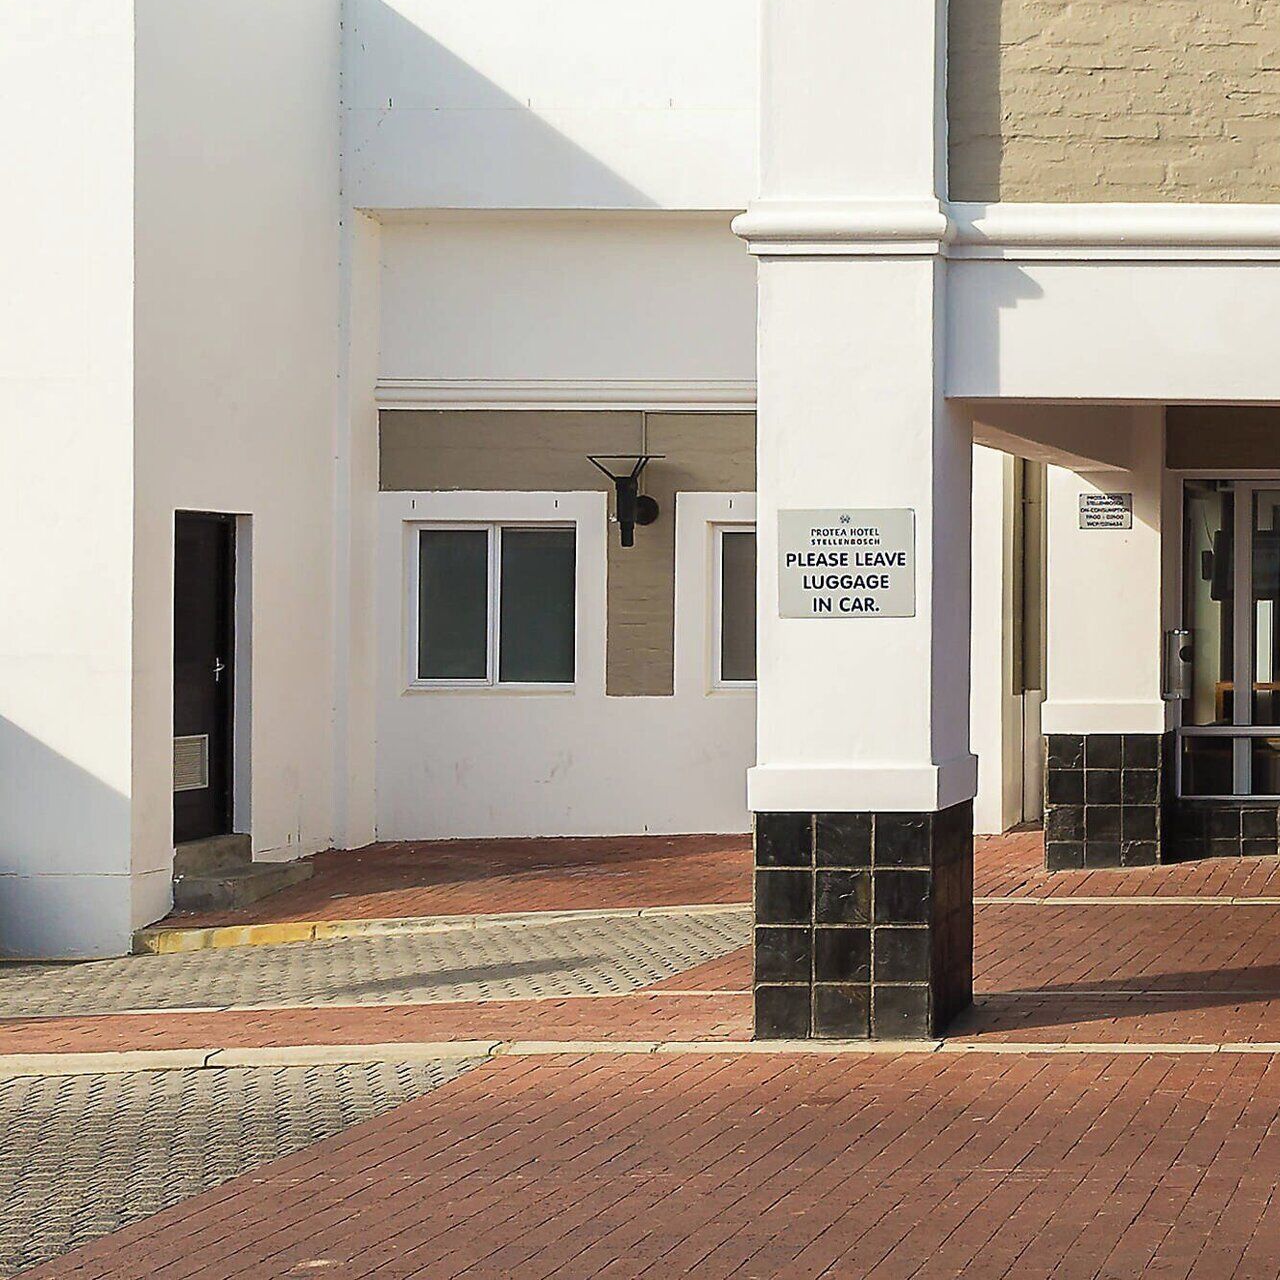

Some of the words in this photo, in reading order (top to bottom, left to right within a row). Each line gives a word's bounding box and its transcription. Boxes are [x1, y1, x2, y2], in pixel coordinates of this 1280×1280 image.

[810, 528, 847, 537] PROTEA
[850, 528, 880, 537] HOTEL
[811, 538, 880, 546] STELLENBOSCH
[786, 552, 849, 568] PLEASE
[855, 552, 906, 567] LEAVE
[803, 574, 890, 590] LUGGAGE
[813, 597, 832, 613] IN
[839, 596, 880, 613] CAR.
